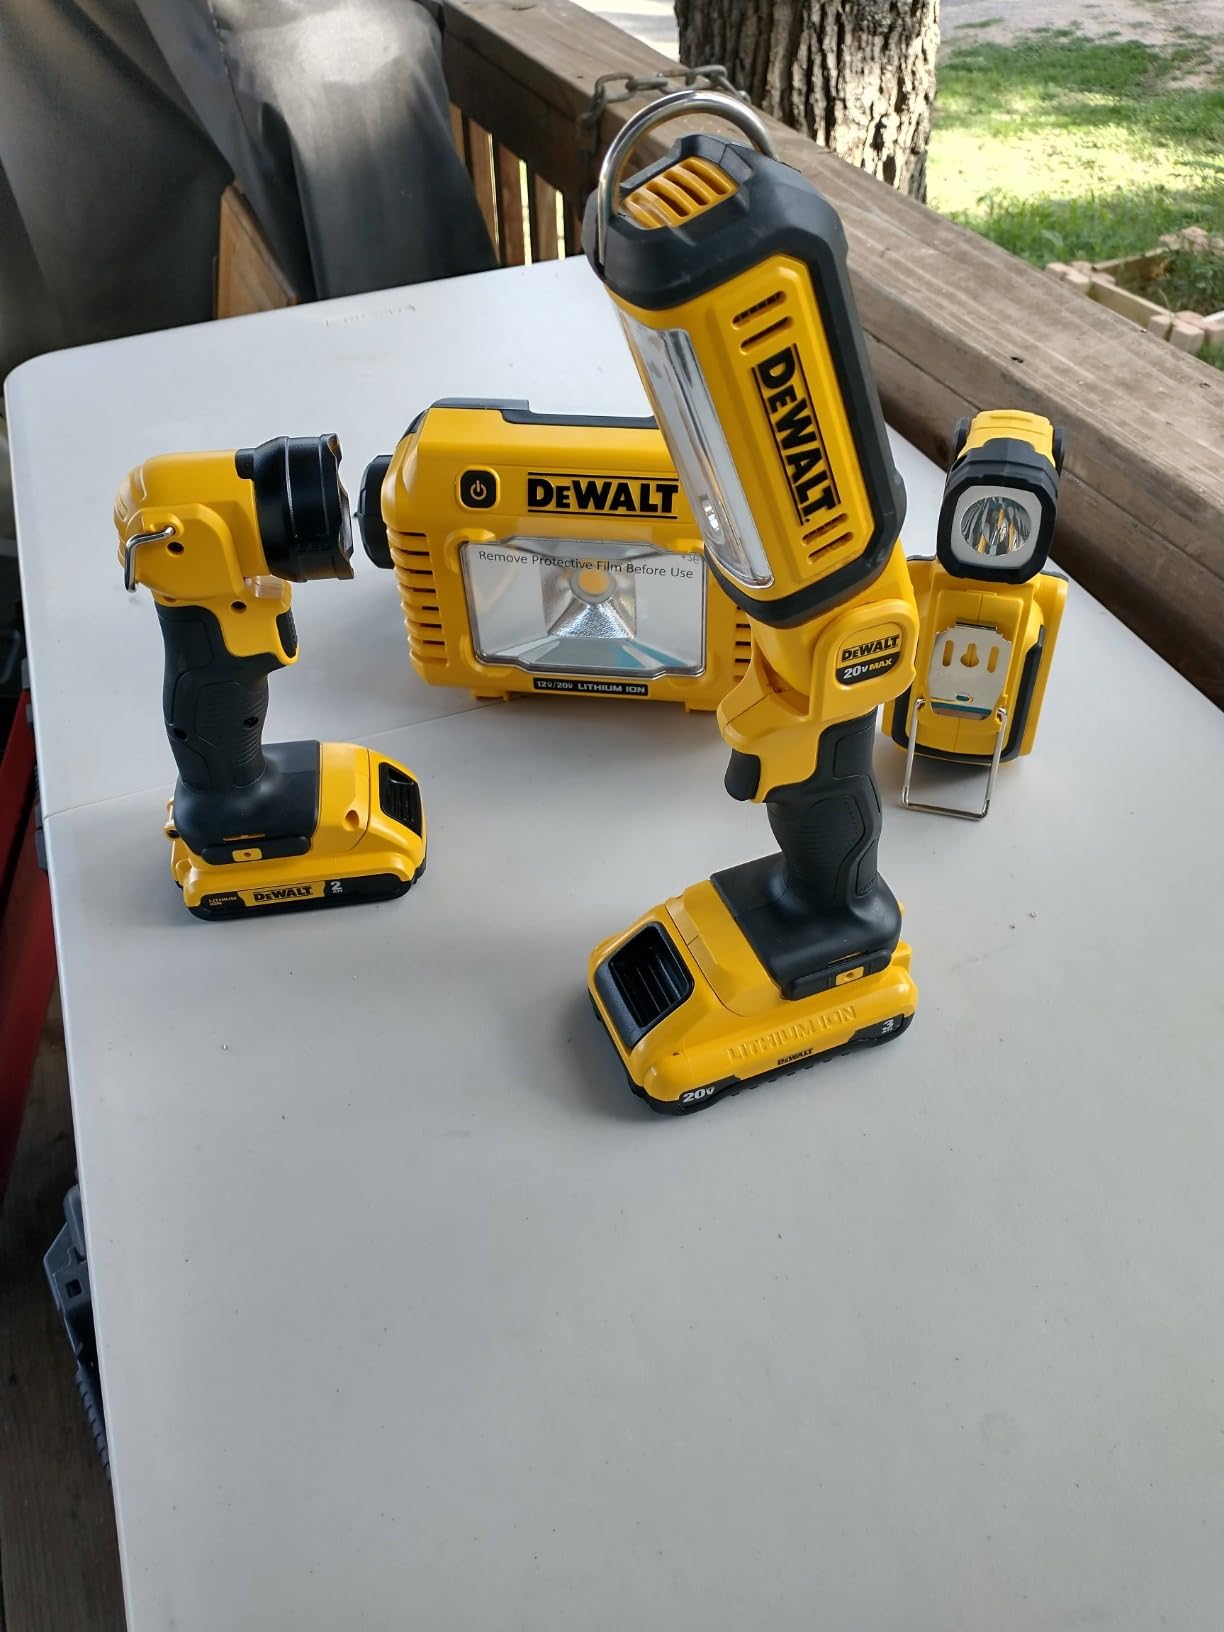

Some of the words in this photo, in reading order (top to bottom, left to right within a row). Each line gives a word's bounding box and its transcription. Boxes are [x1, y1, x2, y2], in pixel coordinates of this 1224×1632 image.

[479, 550, 527, 564] Remove
[531, 555, 593, 571] Protective
[597, 560, 622, 573] Film
[627, 563, 667, 577] Before
[671, 567, 694, 579] Use
[869, 658, 893, 671] MAX
[577, 683, 623, 693] LITHIUM
[625, 685, 646, 694] ION
[330, 881, 343, 891] 2
[727, 1021, 816, 1064] LITHIUM
[817, 1005, 858, 1034] ION
